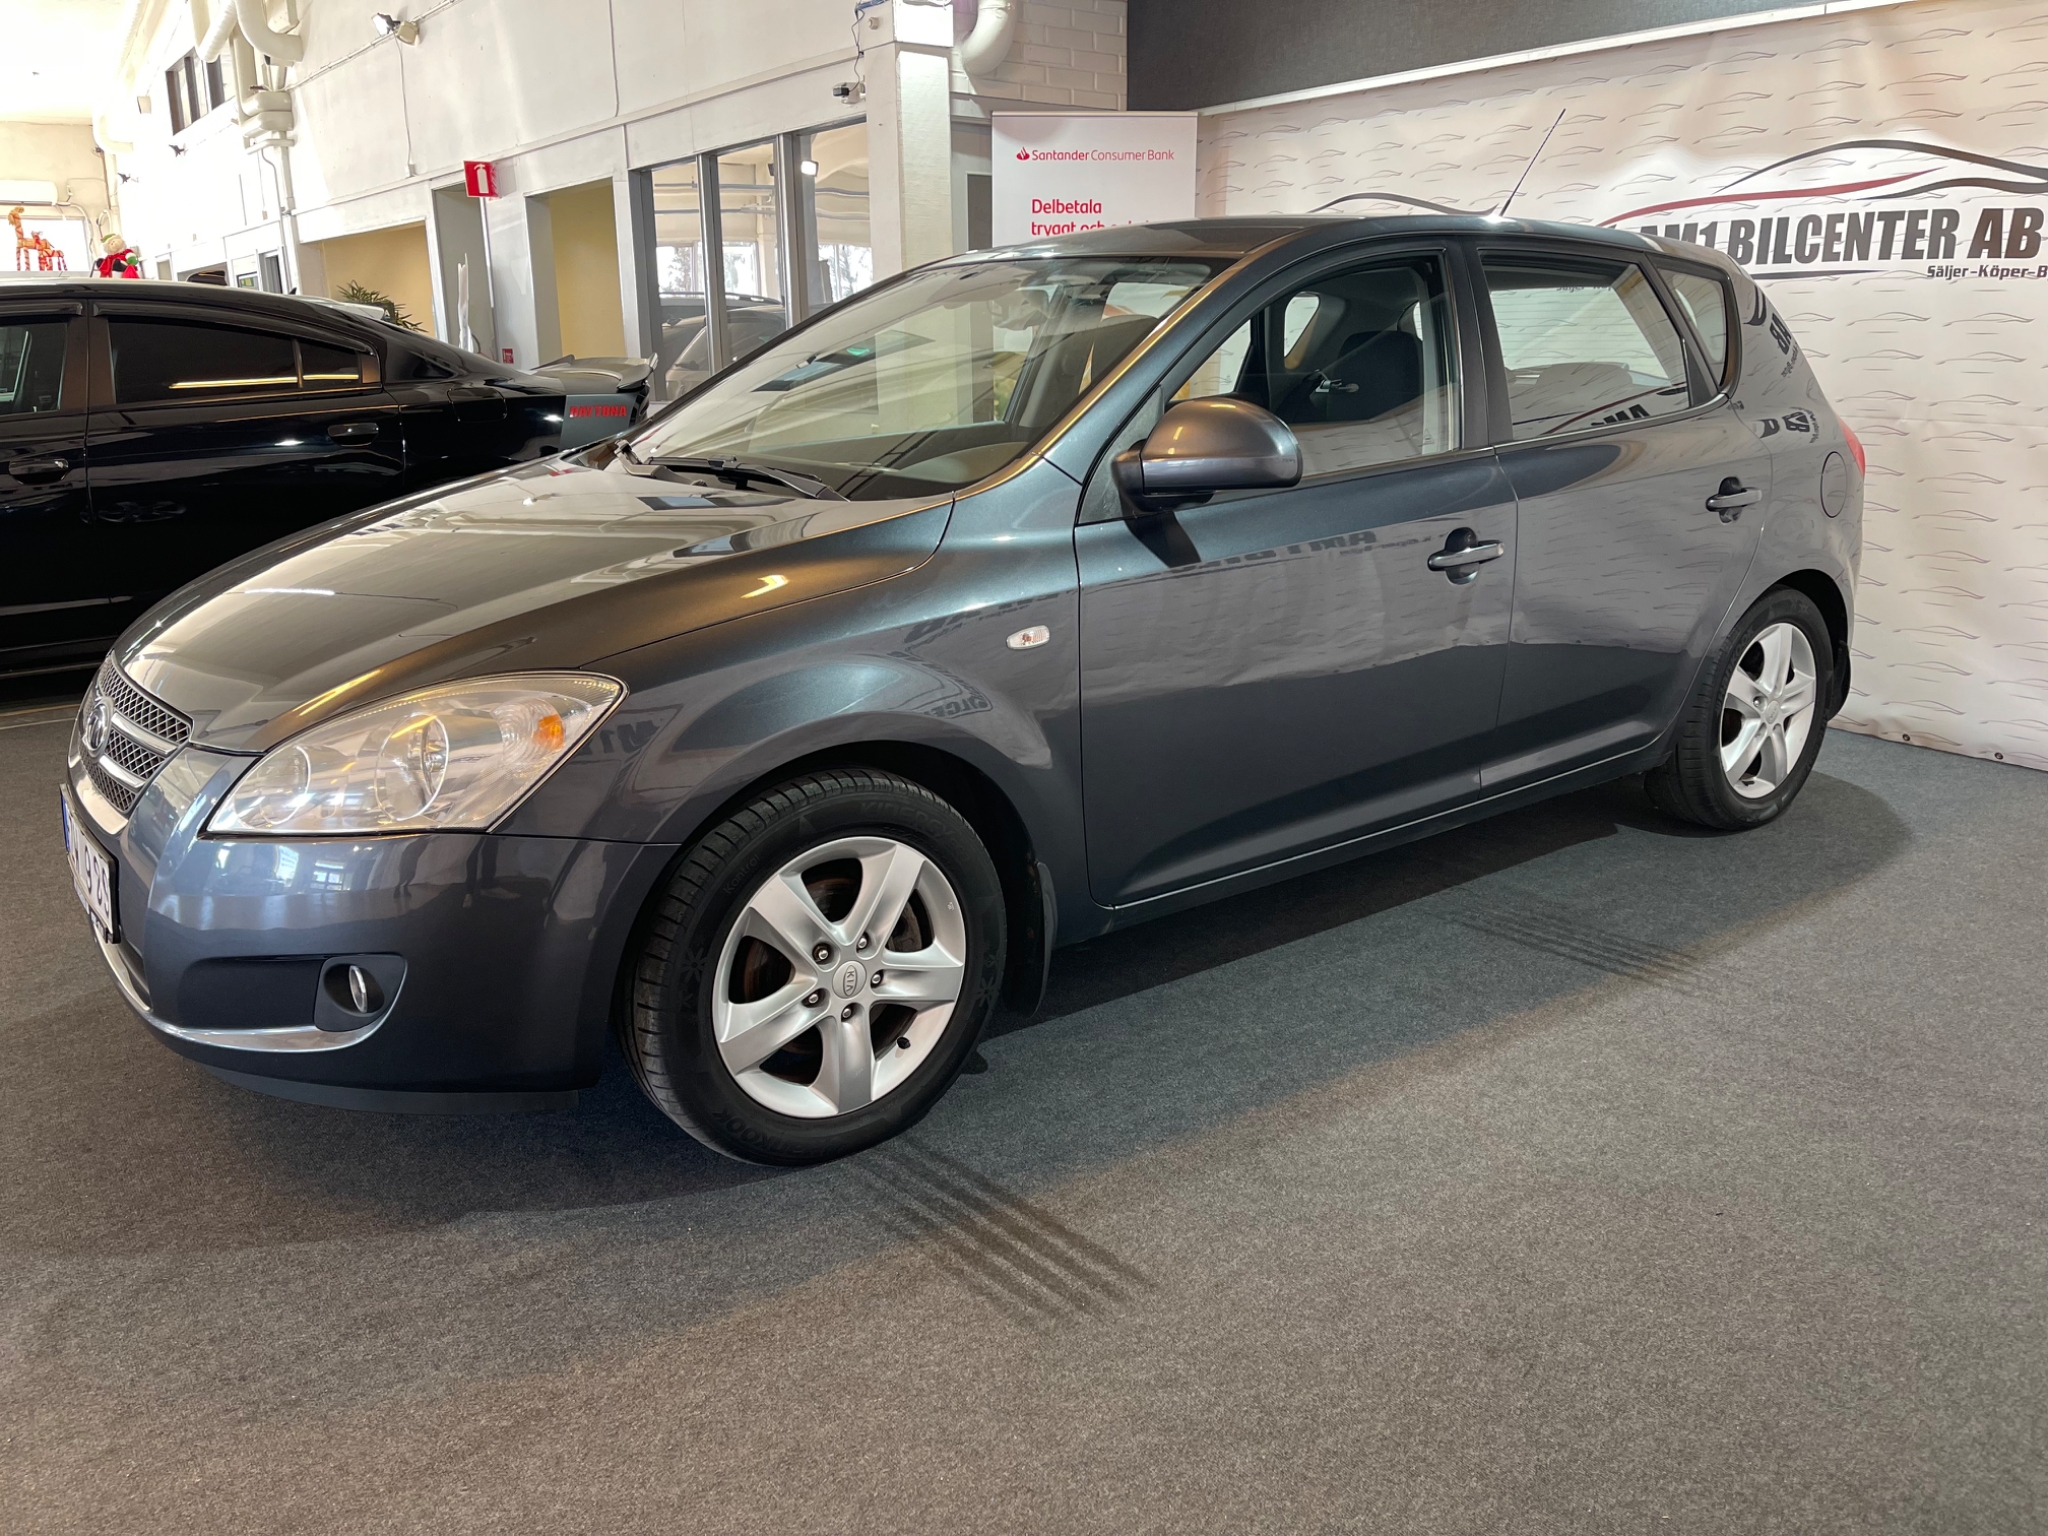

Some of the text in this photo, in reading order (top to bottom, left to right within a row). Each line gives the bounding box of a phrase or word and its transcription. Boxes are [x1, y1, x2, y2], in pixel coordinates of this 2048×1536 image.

[1032, 149, 1174, 161] Santander Consumer Bank
[1031, 198, 1102, 214] Delbetala
[1728, 208, 1960, 265] BILCENTER
[1967, 207, 2044, 259] AB
[569, 405, 627, 418] DAYTONA
